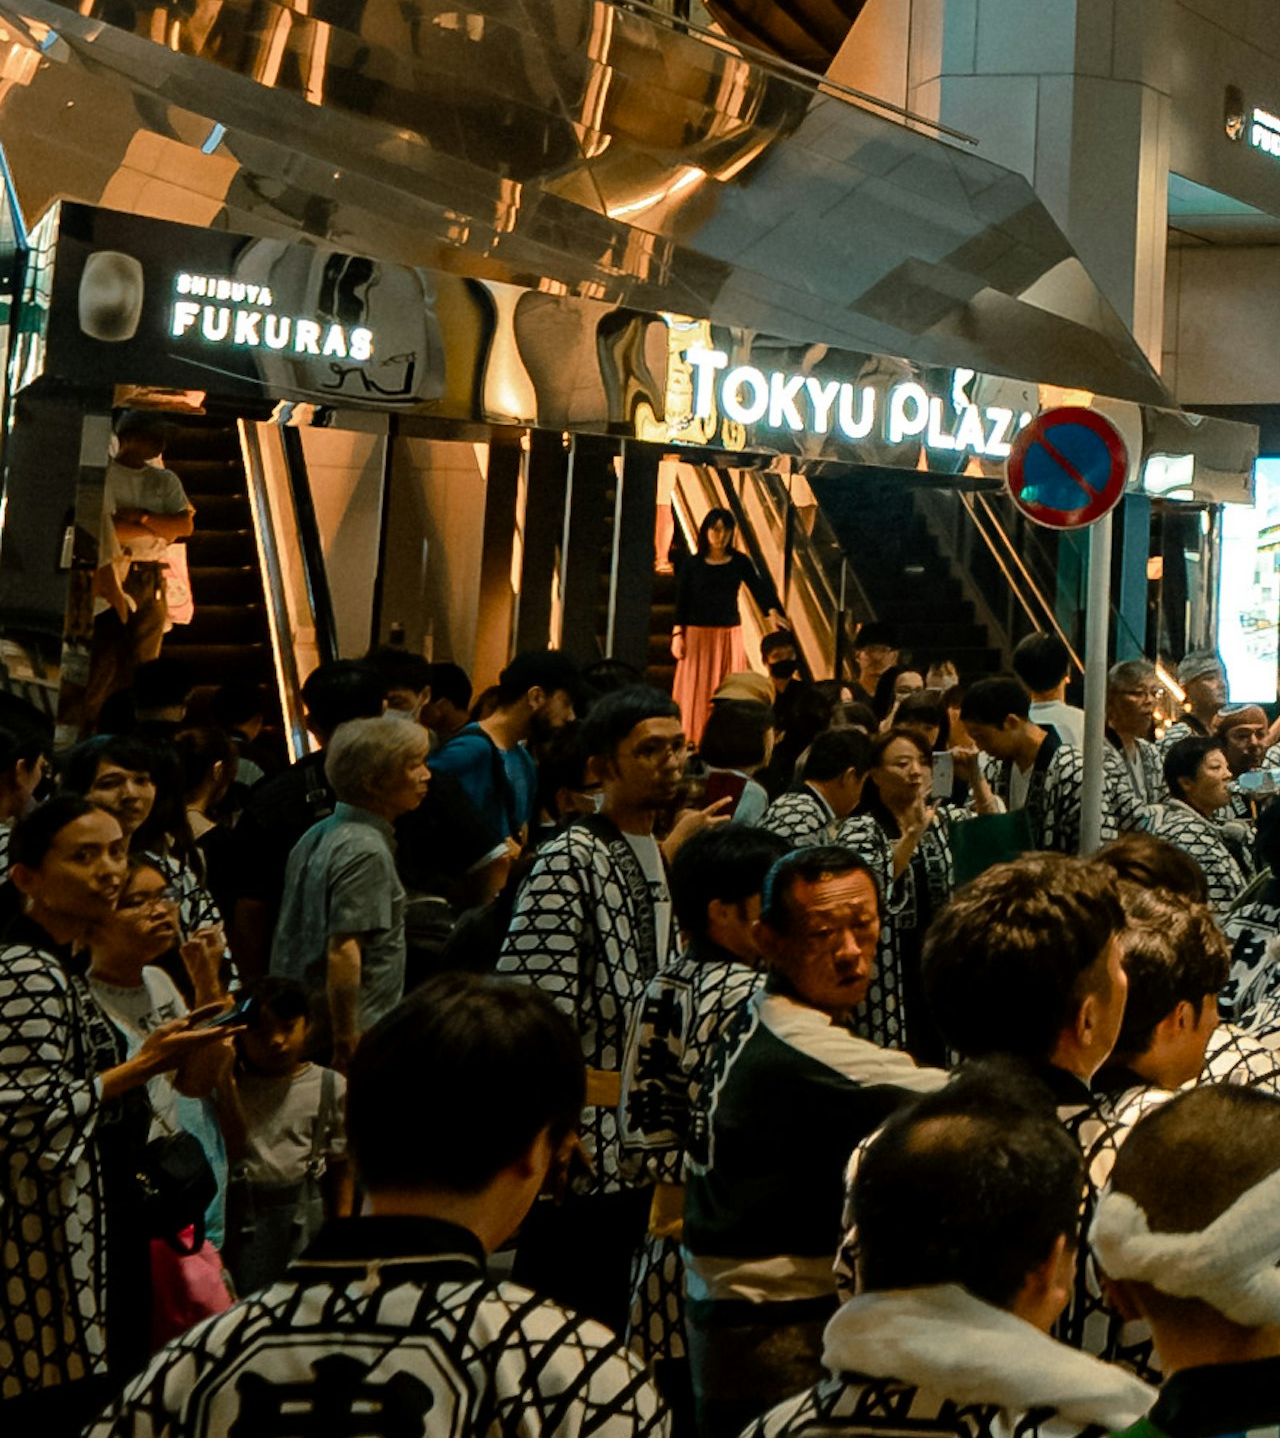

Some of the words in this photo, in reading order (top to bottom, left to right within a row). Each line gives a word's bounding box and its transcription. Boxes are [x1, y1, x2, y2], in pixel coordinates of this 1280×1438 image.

[175, 273, 273, 308] SHIBUYA
[171, 300, 374, 362] FUKURAS
[684, 343, 876, 440] TOKYU
[887, 381, 1028, 458] PLAZ
